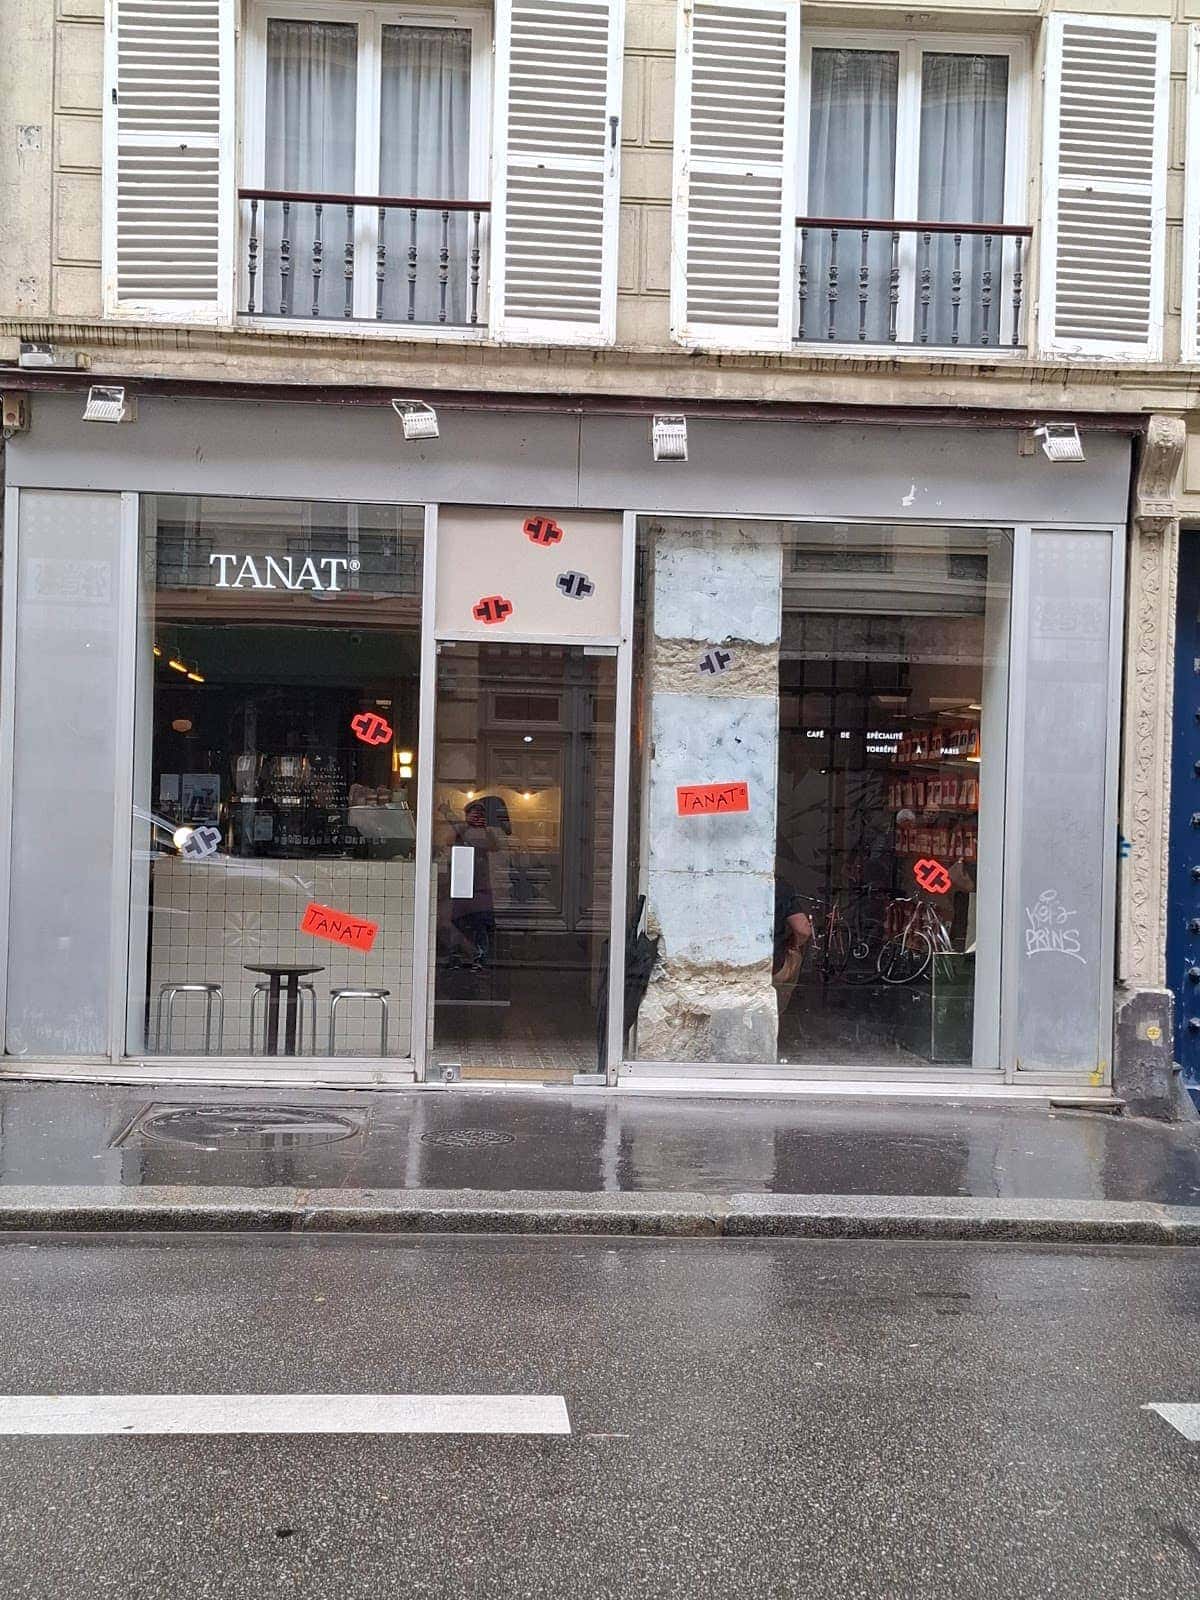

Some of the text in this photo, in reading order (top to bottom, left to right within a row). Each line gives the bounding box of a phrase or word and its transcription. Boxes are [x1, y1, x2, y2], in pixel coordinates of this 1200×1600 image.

[806, 729, 825, 739] CAFÉ
[840, 731, 850, 739] DE
[940, 747, 960, 755] PARIS
